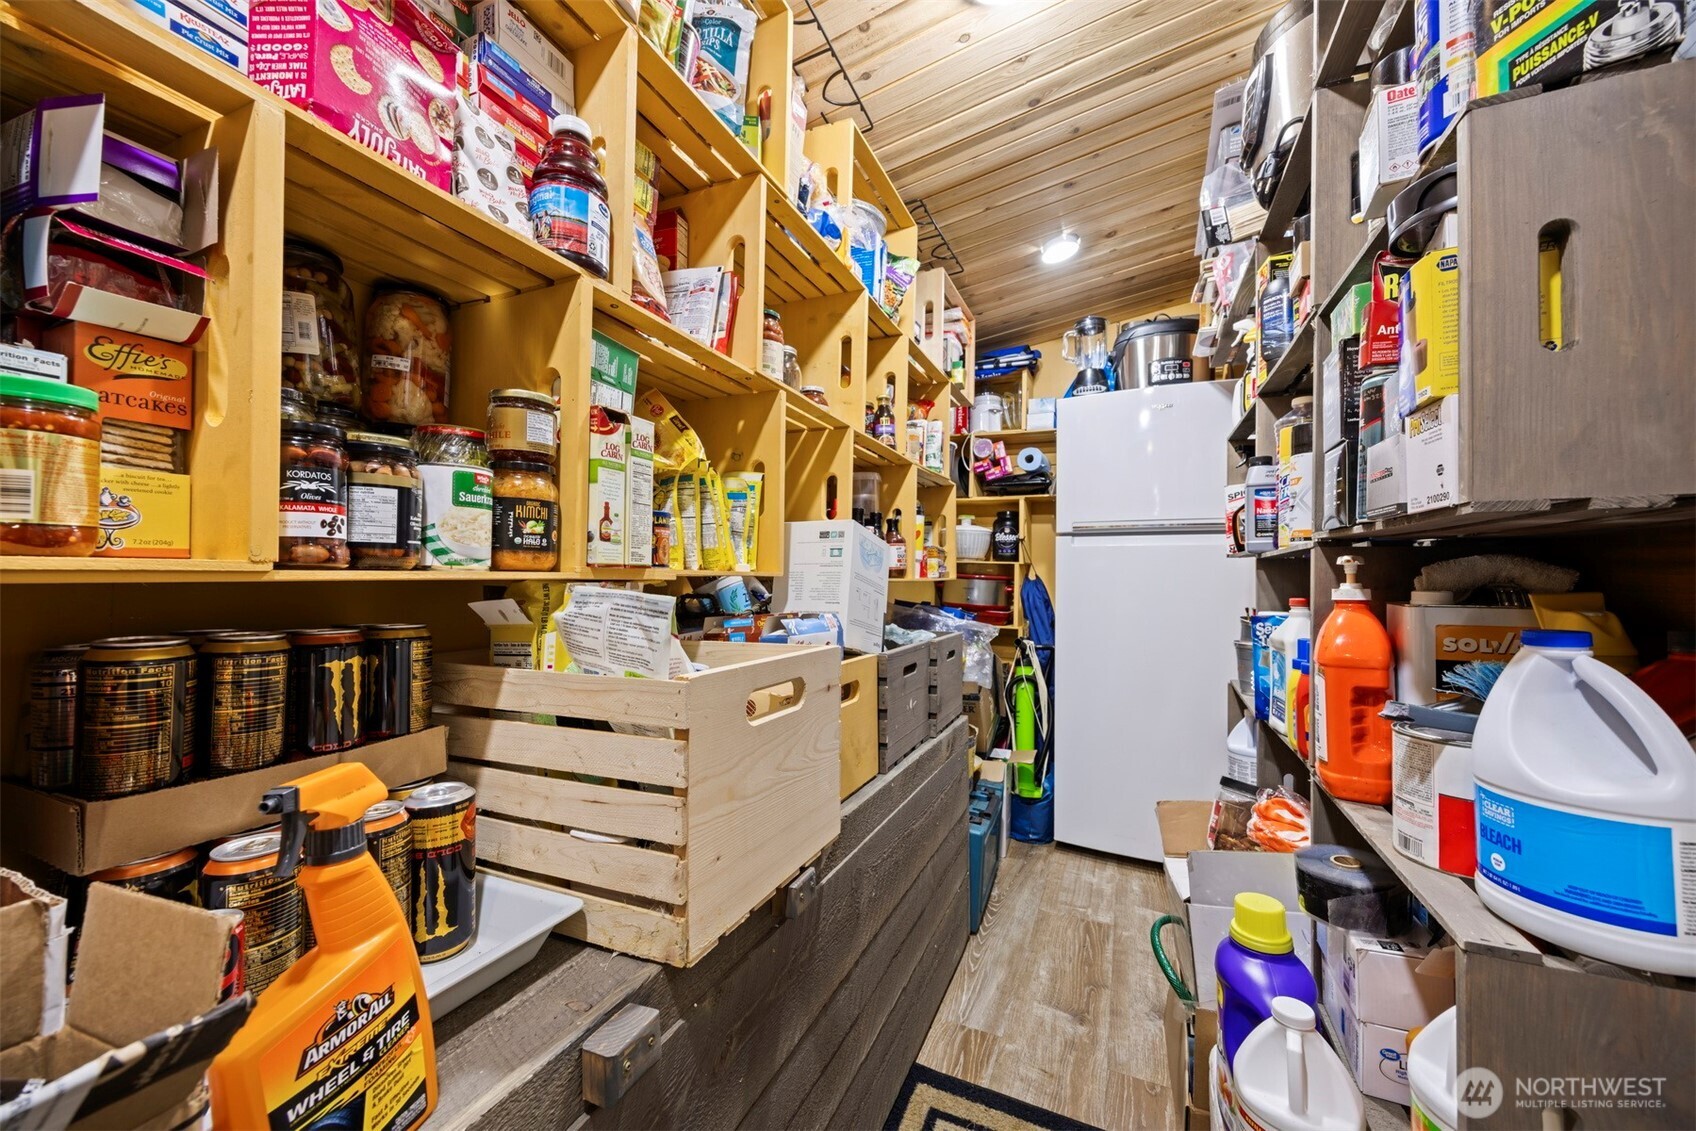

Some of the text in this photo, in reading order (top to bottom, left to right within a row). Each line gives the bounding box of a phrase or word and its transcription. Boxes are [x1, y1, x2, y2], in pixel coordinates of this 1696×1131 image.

[1494, 2, 1546, 42] FOR IMPORTS
[180, 12, 230, 47] KRUSTEAZ
[181, 28, 230, 60] Pie Crust Mix
[1512, 10, 1600, 82] PUISSANCE-V
[1516, 52, 1529, 65] TYPE
[255, 72, 294, 81] MOMENT
[1516, 74, 1529, 87] POUR
[1530, 56, 1555, 78] VOITURES
[1387, 86, 1416, 102] Oate
[348, 118, 397, 160] JULY
[1440, 256, 1458, 269] NAPA
[88, 335, 170, 372] Effie's
[33, 356, 61, 368] Facts
[150, 390, 186, 403] Original
[636, 433, 650, 444] LOG
[606, 442, 620, 453] LOG
[632, 441, 653, 452] CABIN
[601, 450, 623, 461] CABIN
[286, 470, 332, 481] KORDATOS
[1427, 492, 1450, 505] 2100290
[280, 503, 315, 512] KALAMATA
[516, 506, 548, 520] KIMCHI
[140, 665, 173, 674] Facts
[312, 740, 351, 752] COLD
[1484, 800, 1510, 817] CLEAR
[1484, 809, 1511, 824] SAVINGS
[1480, 821, 1522, 855] BLEACH
[427, 844, 462, 858] COLD
[229, 878, 280, 891] Nutrition
[303, 992, 392, 1070] ARMOR ALL
[379, 1023, 412, 1058] CLEANER
[316, 1018, 386, 1082] EXTREME
[286, 1061, 360, 1124] WHEEL
[362, 1047, 375, 1063] &
[376, 1009, 411, 1049] TIRE
